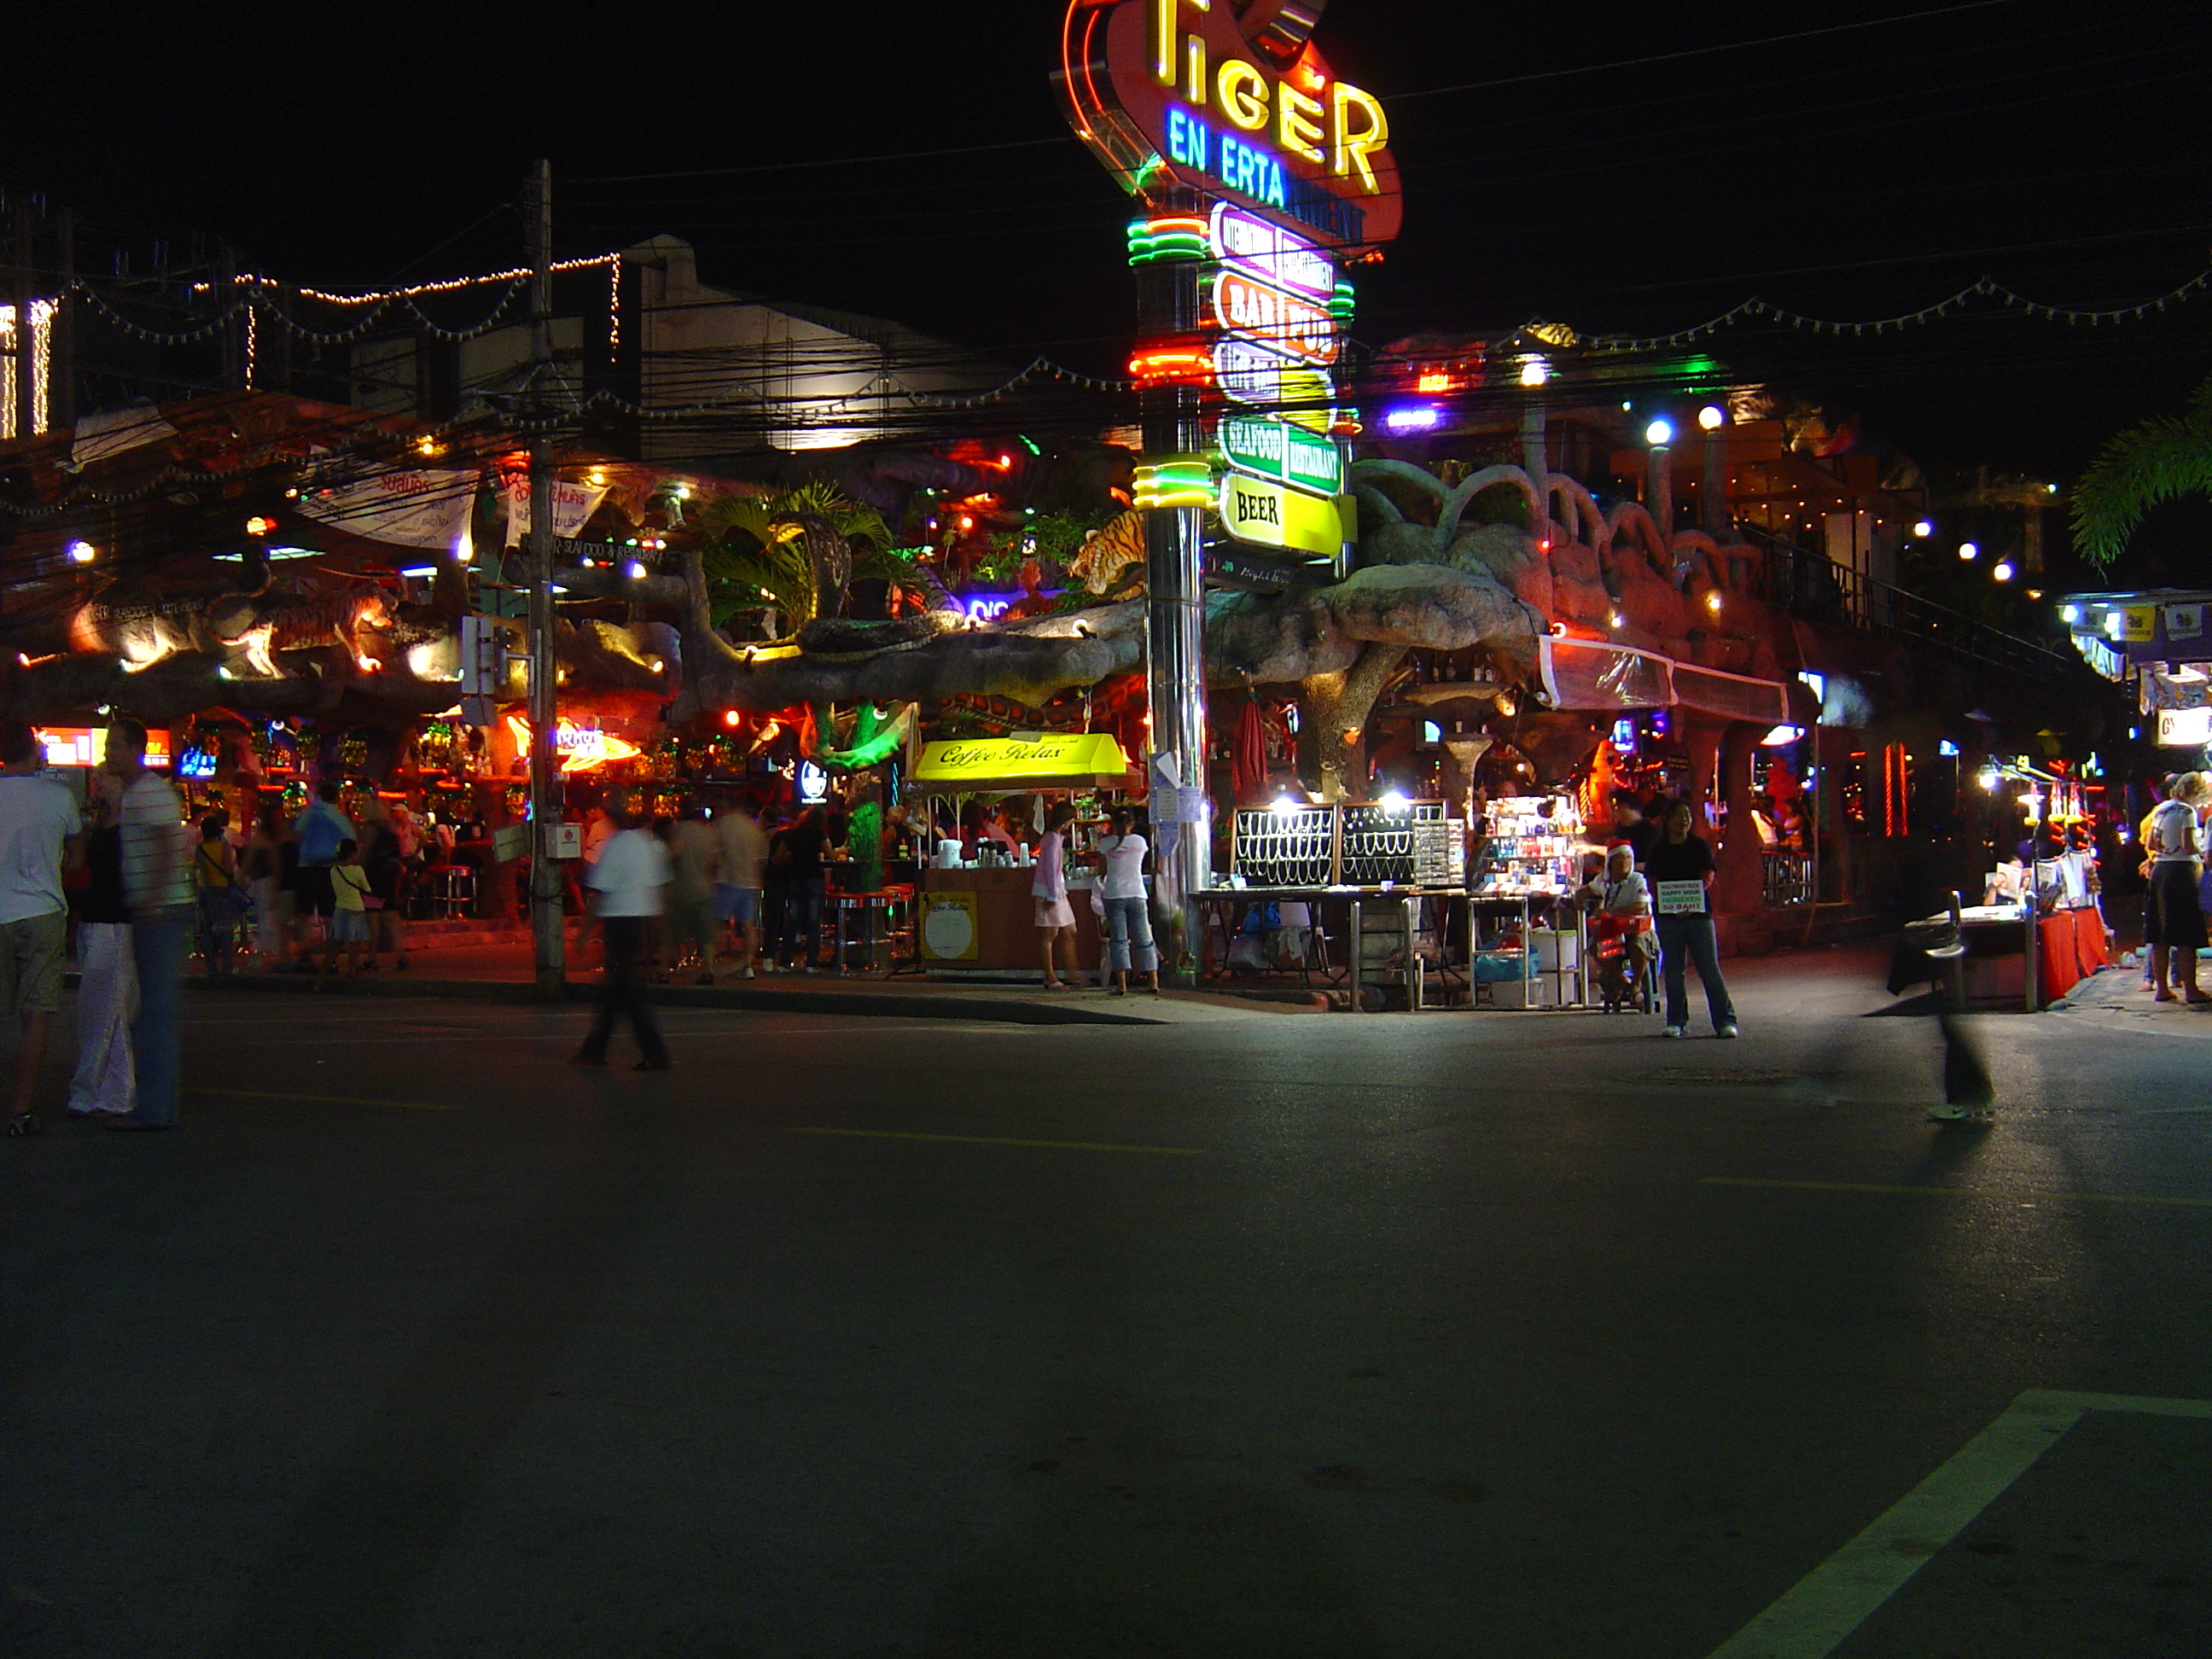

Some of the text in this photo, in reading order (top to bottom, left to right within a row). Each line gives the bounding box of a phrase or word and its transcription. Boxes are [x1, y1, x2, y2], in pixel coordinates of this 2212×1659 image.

[1229, 284, 1332, 352] BAR PUB
[1229, 422, 1337, 480] SEAFOOD RESTAURANT
[1236, 491, 1279, 526] BEER
[940, 742, 1065, 767] Coffee Relax
